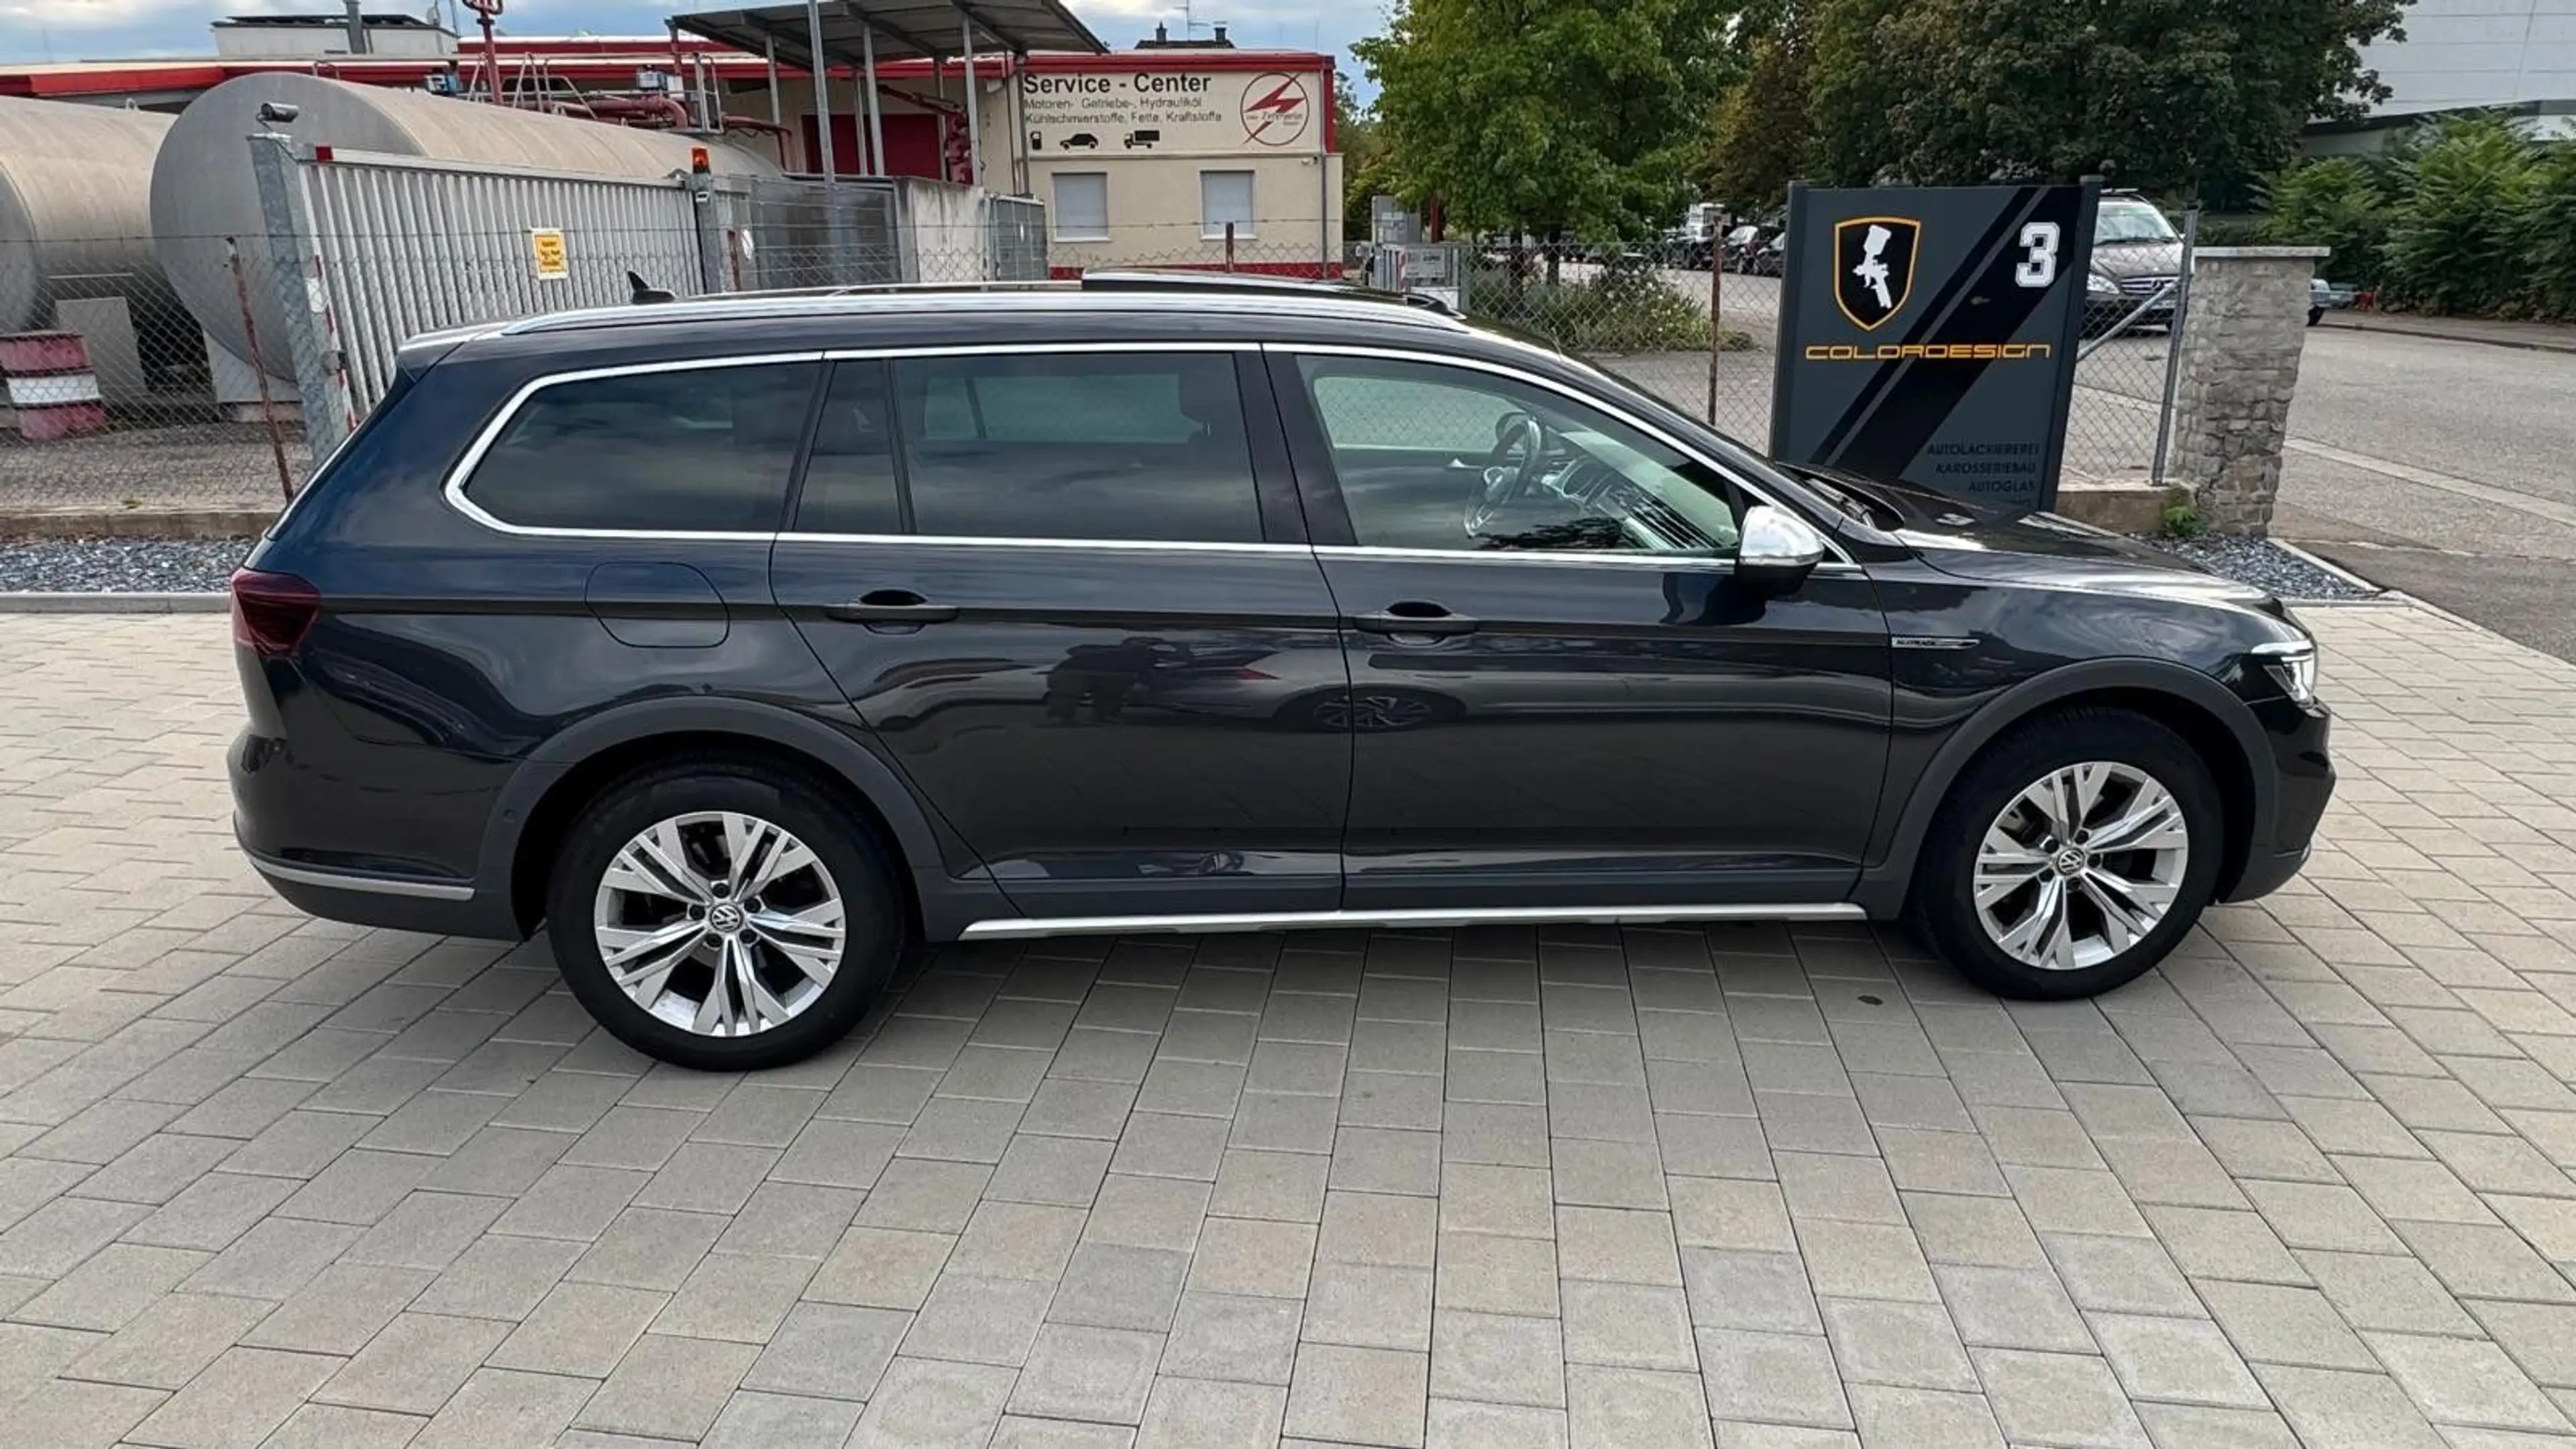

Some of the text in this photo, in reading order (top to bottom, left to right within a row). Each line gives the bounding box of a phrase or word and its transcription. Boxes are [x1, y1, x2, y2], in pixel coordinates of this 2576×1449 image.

[1024, 72, 1111, 93] Service
[1133, 72, 1212, 93] Center
[2015, 221, 2060, 287] 3
[1805, 343, 2051, 360] COLORDESIGN
